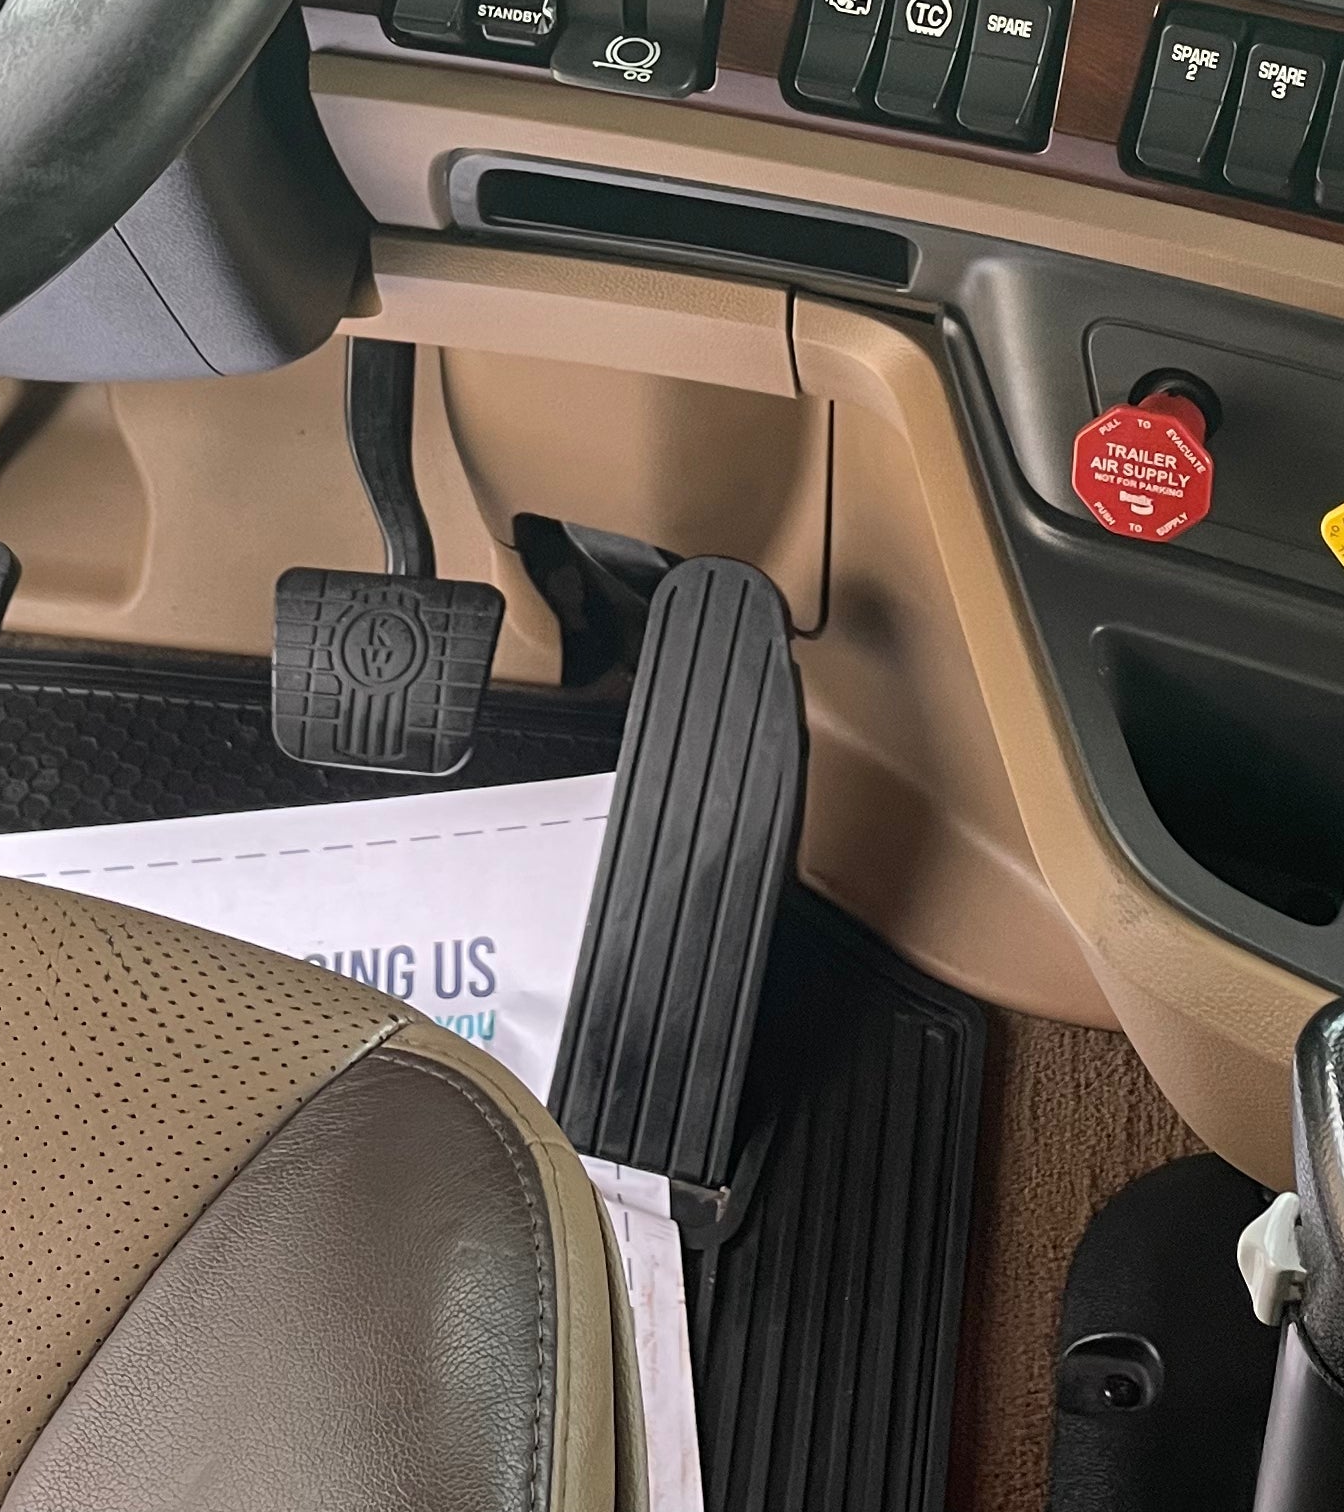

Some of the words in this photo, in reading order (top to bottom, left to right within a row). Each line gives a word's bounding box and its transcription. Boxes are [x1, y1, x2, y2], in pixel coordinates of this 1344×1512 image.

[478, 4, 542, 25] STANDBY
[916, 3, 944, 27] TC
[987, 14, 1033, 38] SPARE
[1171, 43, 1220, 69] SPARE
[1185, 64, 1198, 81] 2
[1258, 61, 1307, 87] SPARE
[1271, 82, 1286, 99] 3
[1098, 418, 1121, 436] PULL
[1137, 419, 1151, 429] TO
[1166, 428, 1206, 474] EVACUATE
[1106, 442, 1177, 470] TRAILER
[1091, 456, 1118, 474] AIR
[1123, 463, 1191, 488] SUPPLY
[1094, 472, 1116, 483] NOT
[1116, 476, 1138, 487] FOR
[1139, 482, 1184, 498] PARKING
[1094, 501, 1116, 526] PUSH
[1128, 522, 1142, 533] TO
[1156, 511, 1189, 537] SUPPLY
[1330, 525, 1340, 538] TO
[433, 936, 496, 999] US
